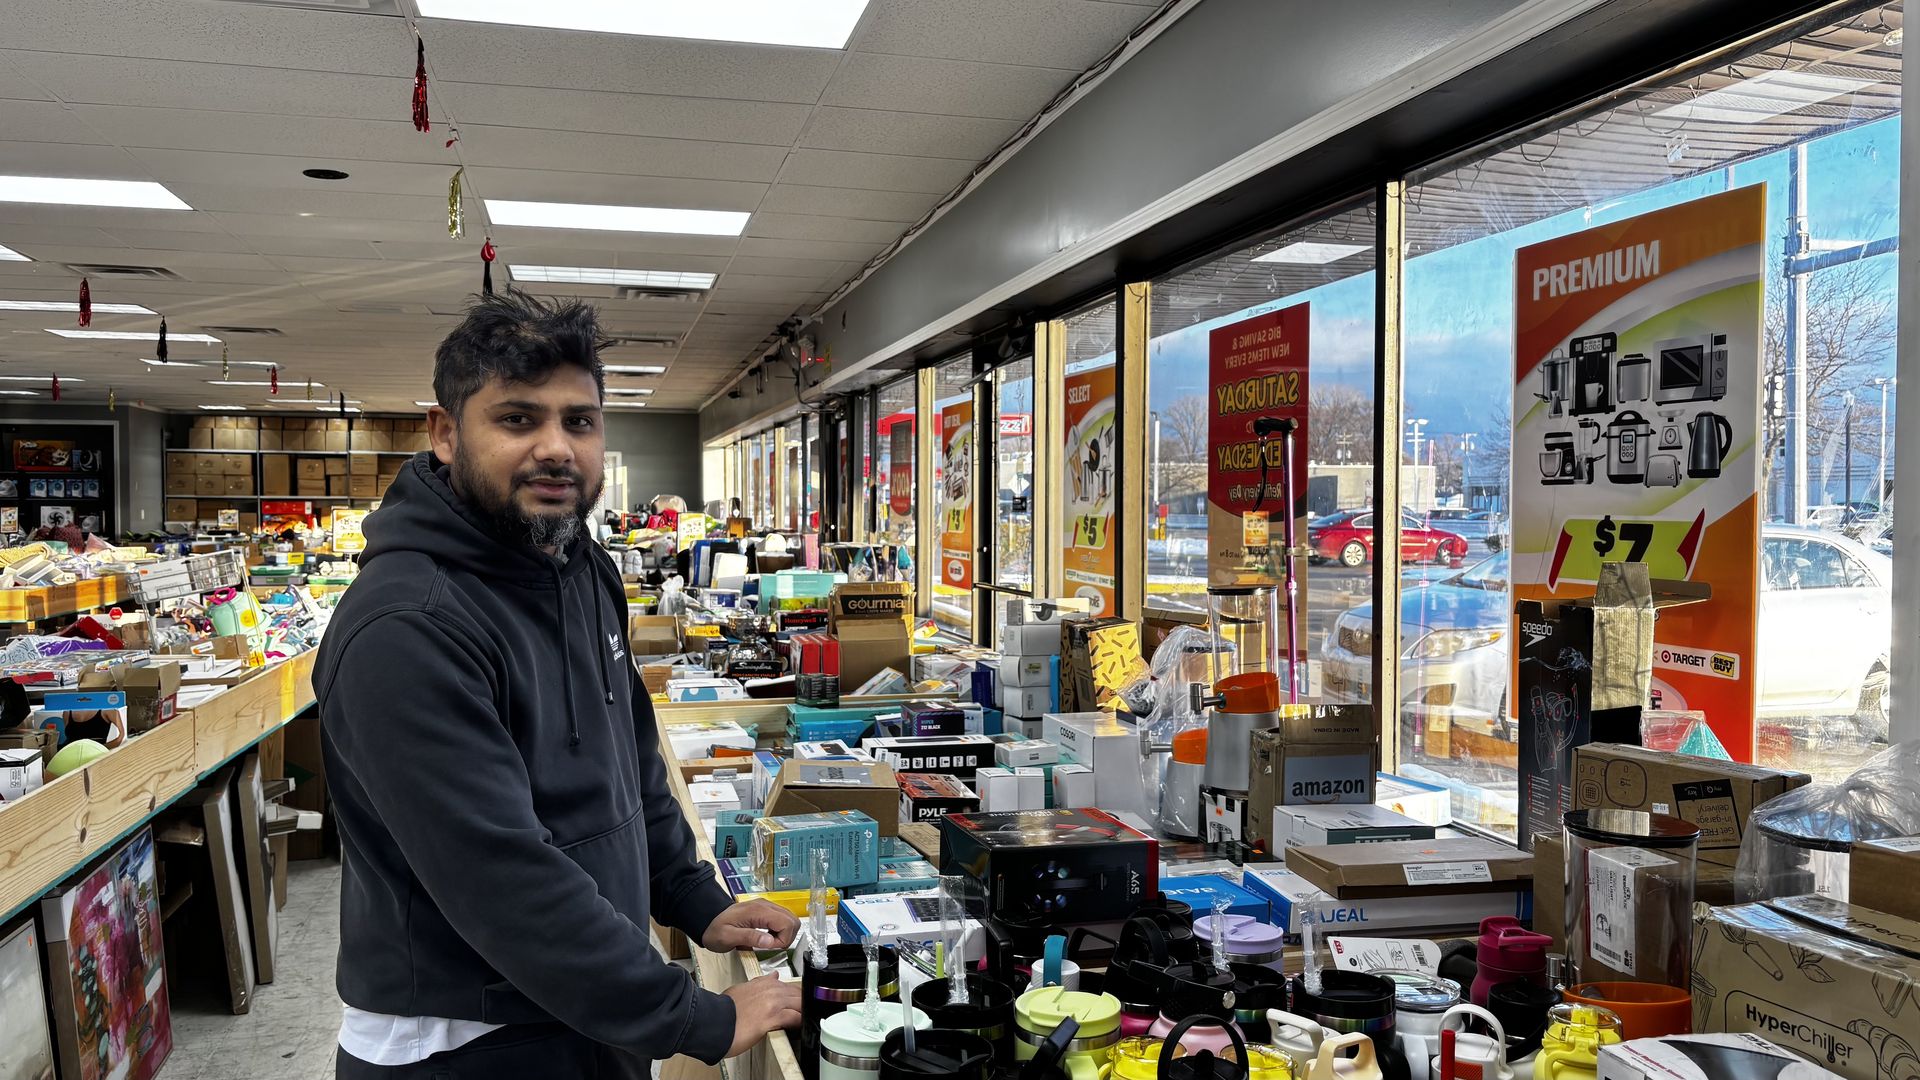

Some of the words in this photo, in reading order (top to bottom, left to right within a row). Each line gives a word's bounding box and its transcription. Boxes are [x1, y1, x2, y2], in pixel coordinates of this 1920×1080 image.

[1532, 239, 1661, 301] PREMIUM
[1068, 384, 1092, 405] SELECT
[952, 508, 961, 530] $3
[1083, 513, 1098, 546] $5
[1593, 514, 1654, 563] $7
[848, 597, 906, 610] Gourmia
[1522, 621, 1553, 637] speedo
[1672, 652, 1706, 667] TARGET
[1713, 656, 1735, 668] BEST
[1713, 663, 1732, 674] BUY
[1060, 726, 1076, 742] COSORI
[1292, 777, 1365, 798] amazon
[919, 807, 947, 818] PYLE
[1700, 827, 1719, 837] FREE
[1719, 826, 1735, 836] Get
[1130, 869, 1140, 895] A65
[1745, 1003, 1854, 1064] HyperChiller
